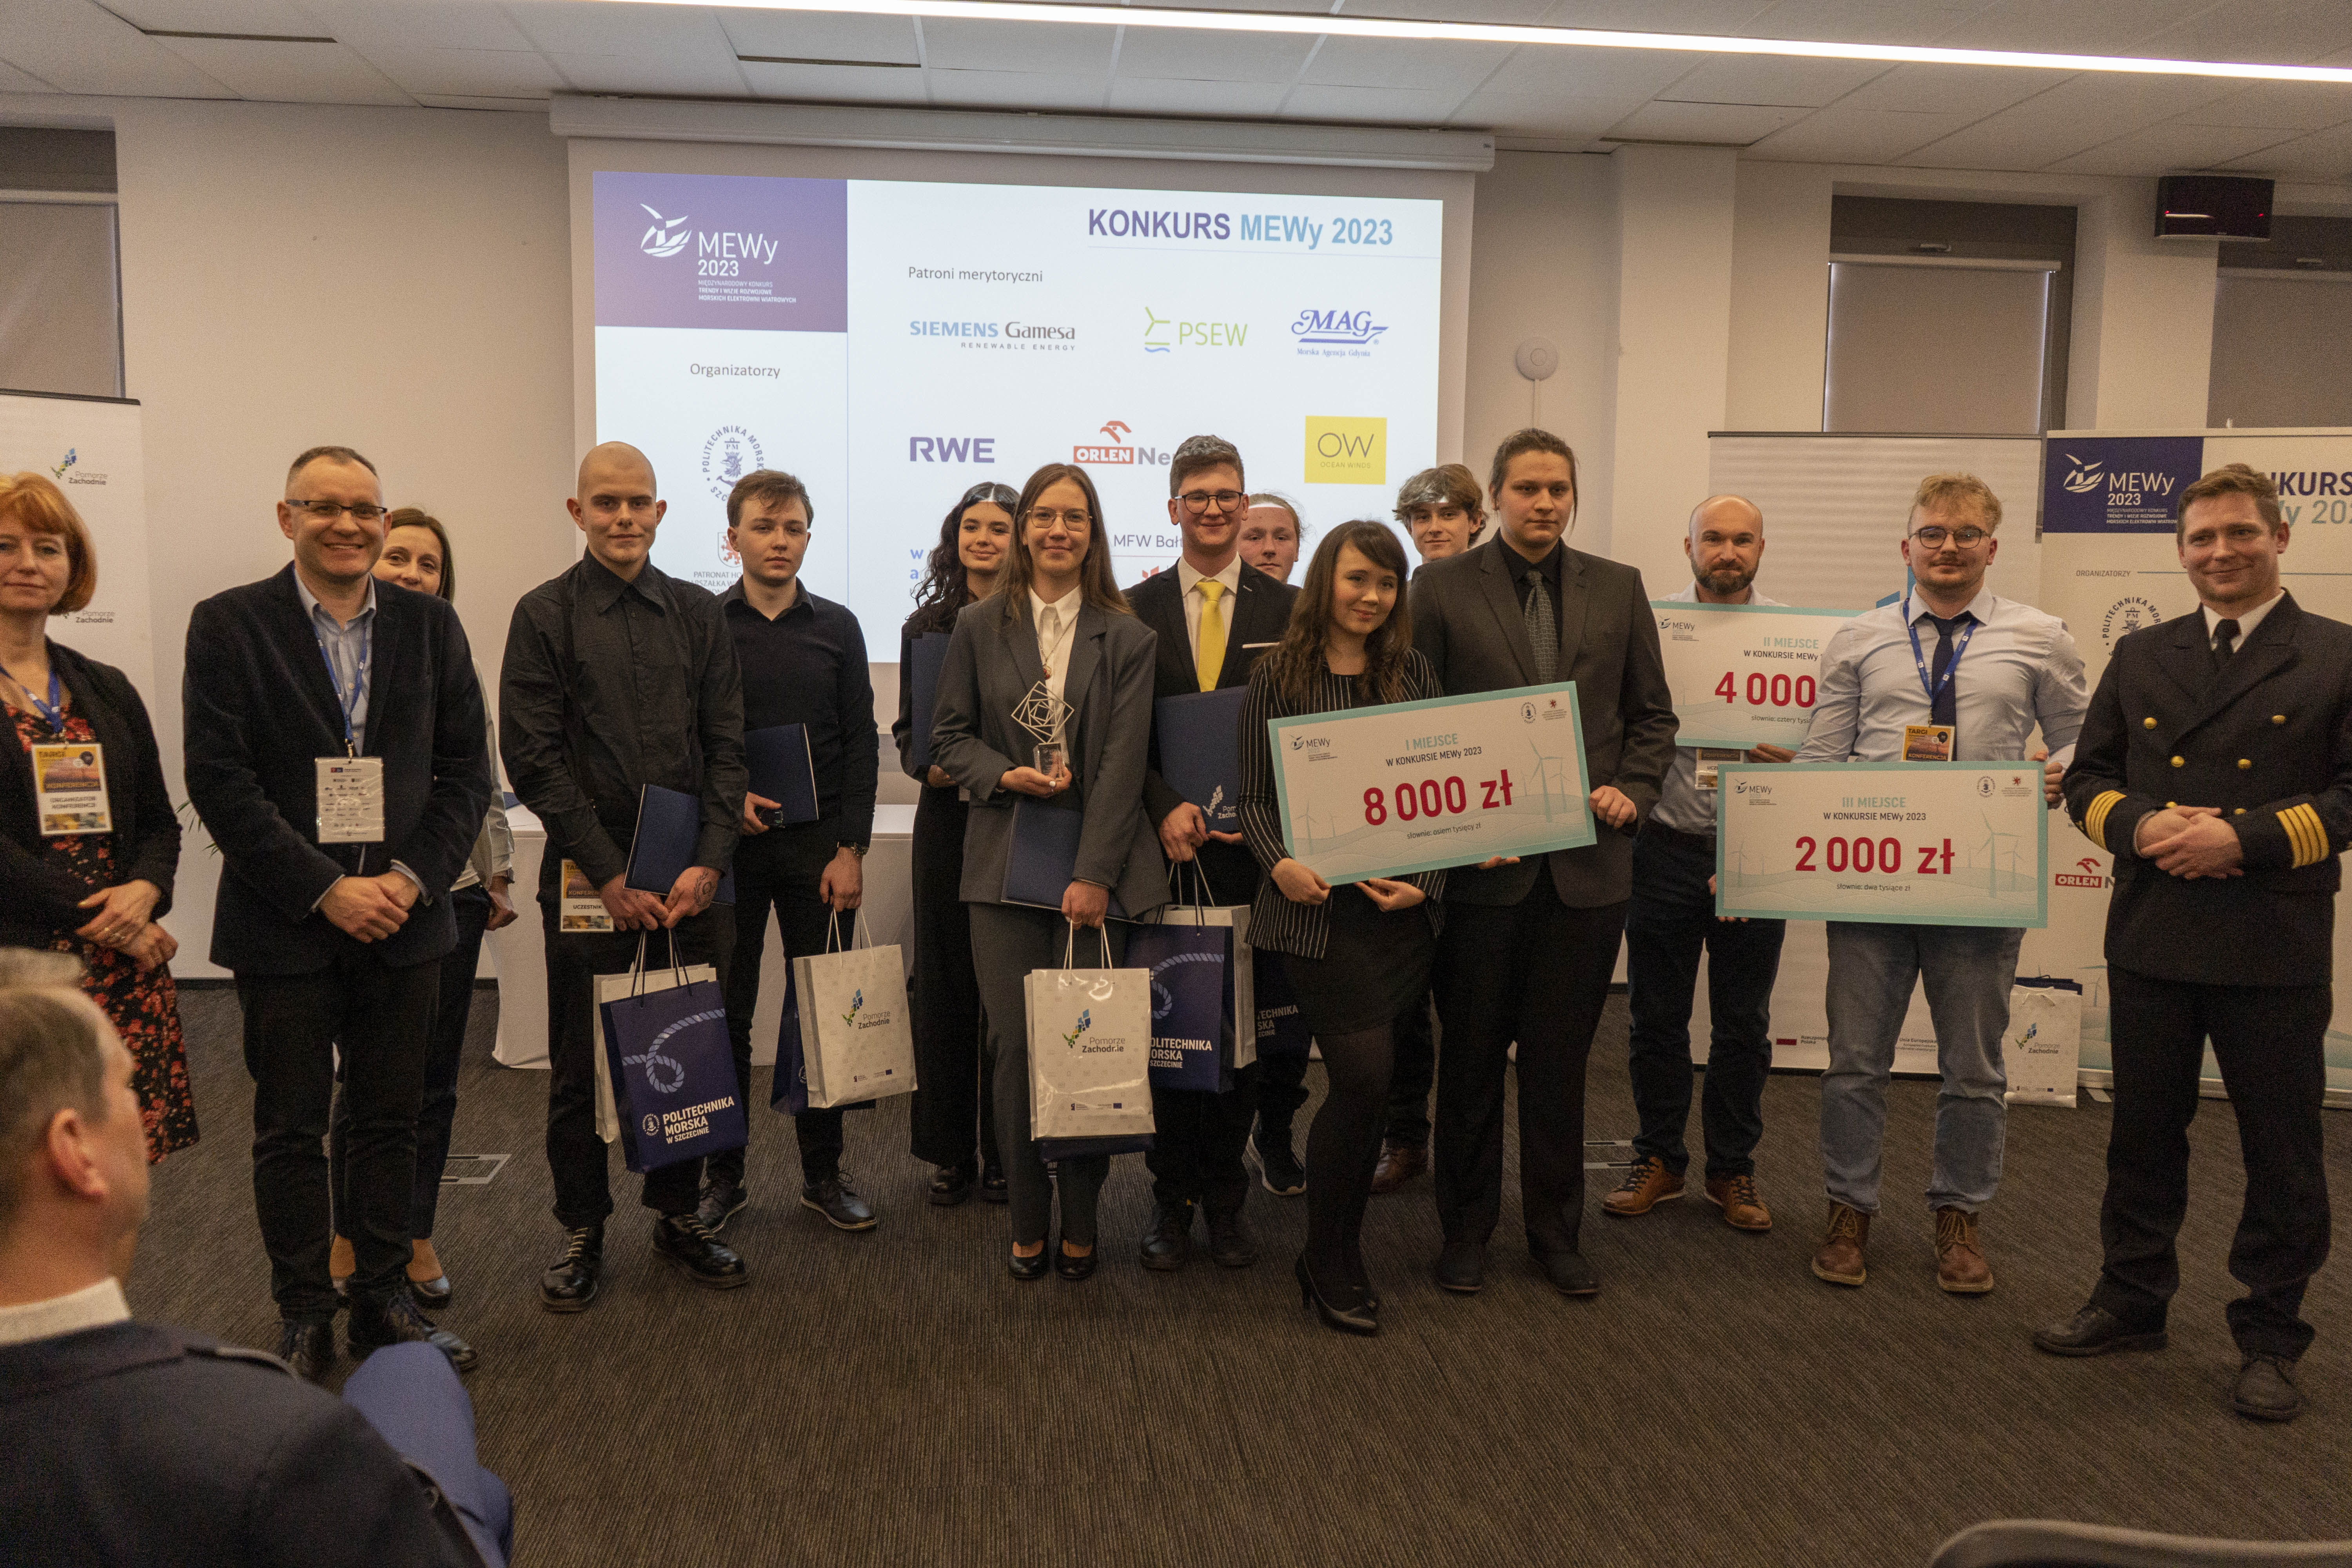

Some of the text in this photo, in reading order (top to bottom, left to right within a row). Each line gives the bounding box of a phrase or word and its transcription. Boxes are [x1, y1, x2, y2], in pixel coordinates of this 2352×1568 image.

[1088, 209, 1393, 250] KONKURS MEWy 2023
[699, 231, 778, 265] MEWy
[698, 259, 739, 276] 2023
[909, 267, 1043, 284] Patroni merytoryczni
[910, 321, 1075, 339] SIEMENS Gamesa
[1291, 310, 1373, 336] MAG
[1179, 321, 1247, 347] PSEW
[1322, 349, 1346, 358] Agencja
[1348, 349, 1370, 358] Gdynia
[690, 363, 780, 379] Organizatorzy
[702, 425, 764, 473] POLITECHNIKA MORSK
[909, 436, 995, 463] RWE
[1318, 432, 1374, 458] OW
[1076, 448, 1131, 463] ORLEN
[2109, 472, 2175, 496] MEWy
[2271, 472, 2352, 496] KURS
[2107, 493, 2141, 506] 2023
[1114, 534, 1183, 548] MFW Bałt
[2102, 597, 2148, 639] POLITECHNIKA
[1672, 622, 1695, 631] MEWy
[1764, 637, 1819, 649] II MIEJSCE
[1753, 650, 1794, 659] KONKURSIE
[1797, 652, 1818, 662] MEWy
[1715, 671, 1816, 708] 4 000
[1306, 738, 1330, 748] MEWy
[1405, 733, 1459, 751] I MIEJSCE
[1386, 746, 1482, 767] W KONKURSIE MEWy 2023
[1363, 769, 1513, 826] 8 000 zł
[1749, 786, 1772, 795] MEWy
[1842, 797, 1906, 808] III MIEJSCE
[1880, 812, 1904, 822] MEWy
[1407, 830, 1432, 839] słownie:
[1453, 824, 1474, 833] tysięcy
[1795, 836, 1955, 874] 2 000 zł
[2057, 875, 2099, 886] ORLEN
[863, 1010, 891, 1021] Pomorze
[1258, 1005, 1299, 1019] ECHNIKA
[858, 1017, 890, 1029] Zachodnie
[1150, 1037, 1212, 1051] OLITECHNIKA
[1150, 1049, 1183, 1061] ORSKA
[1150, 1060, 1183, 1069] SZCZECINIE
[662, 1095, 735, 1125] POLITECHNIKA
[664, 1115, 709, 1136] MORSKA
[675, 1126, 710, 1142] SZCZECINIE
